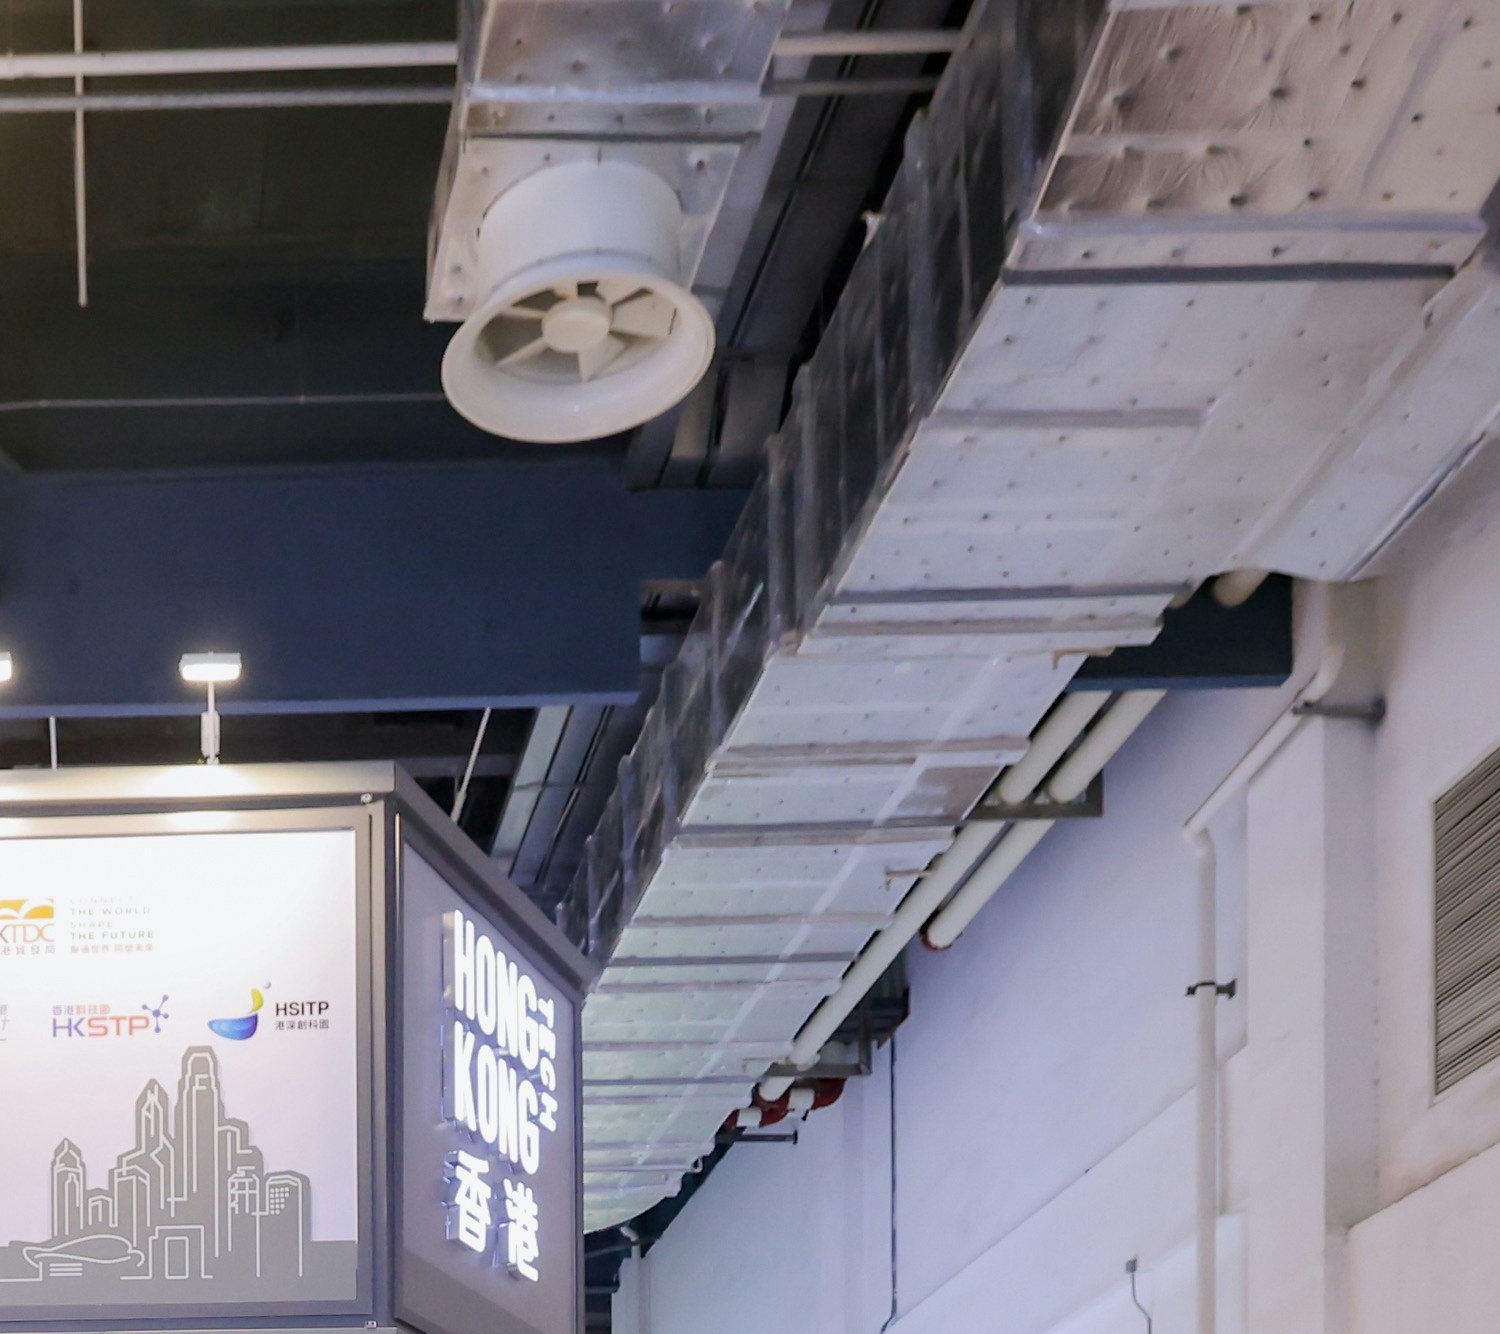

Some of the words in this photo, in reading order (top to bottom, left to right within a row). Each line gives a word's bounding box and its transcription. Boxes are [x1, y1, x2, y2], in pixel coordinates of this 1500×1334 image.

[70, 931, 95, 940] THE
[101, 930, 154, 940] FUTURE
[52, 1016, 150, 1038] HKSTP
[275, 1001, 330, 1017] HSITP
[453, 909, 538, 1070] HONG
[453, 1021, 540, 1175] KONG
[454, 1149, 540, 1282] 香港
